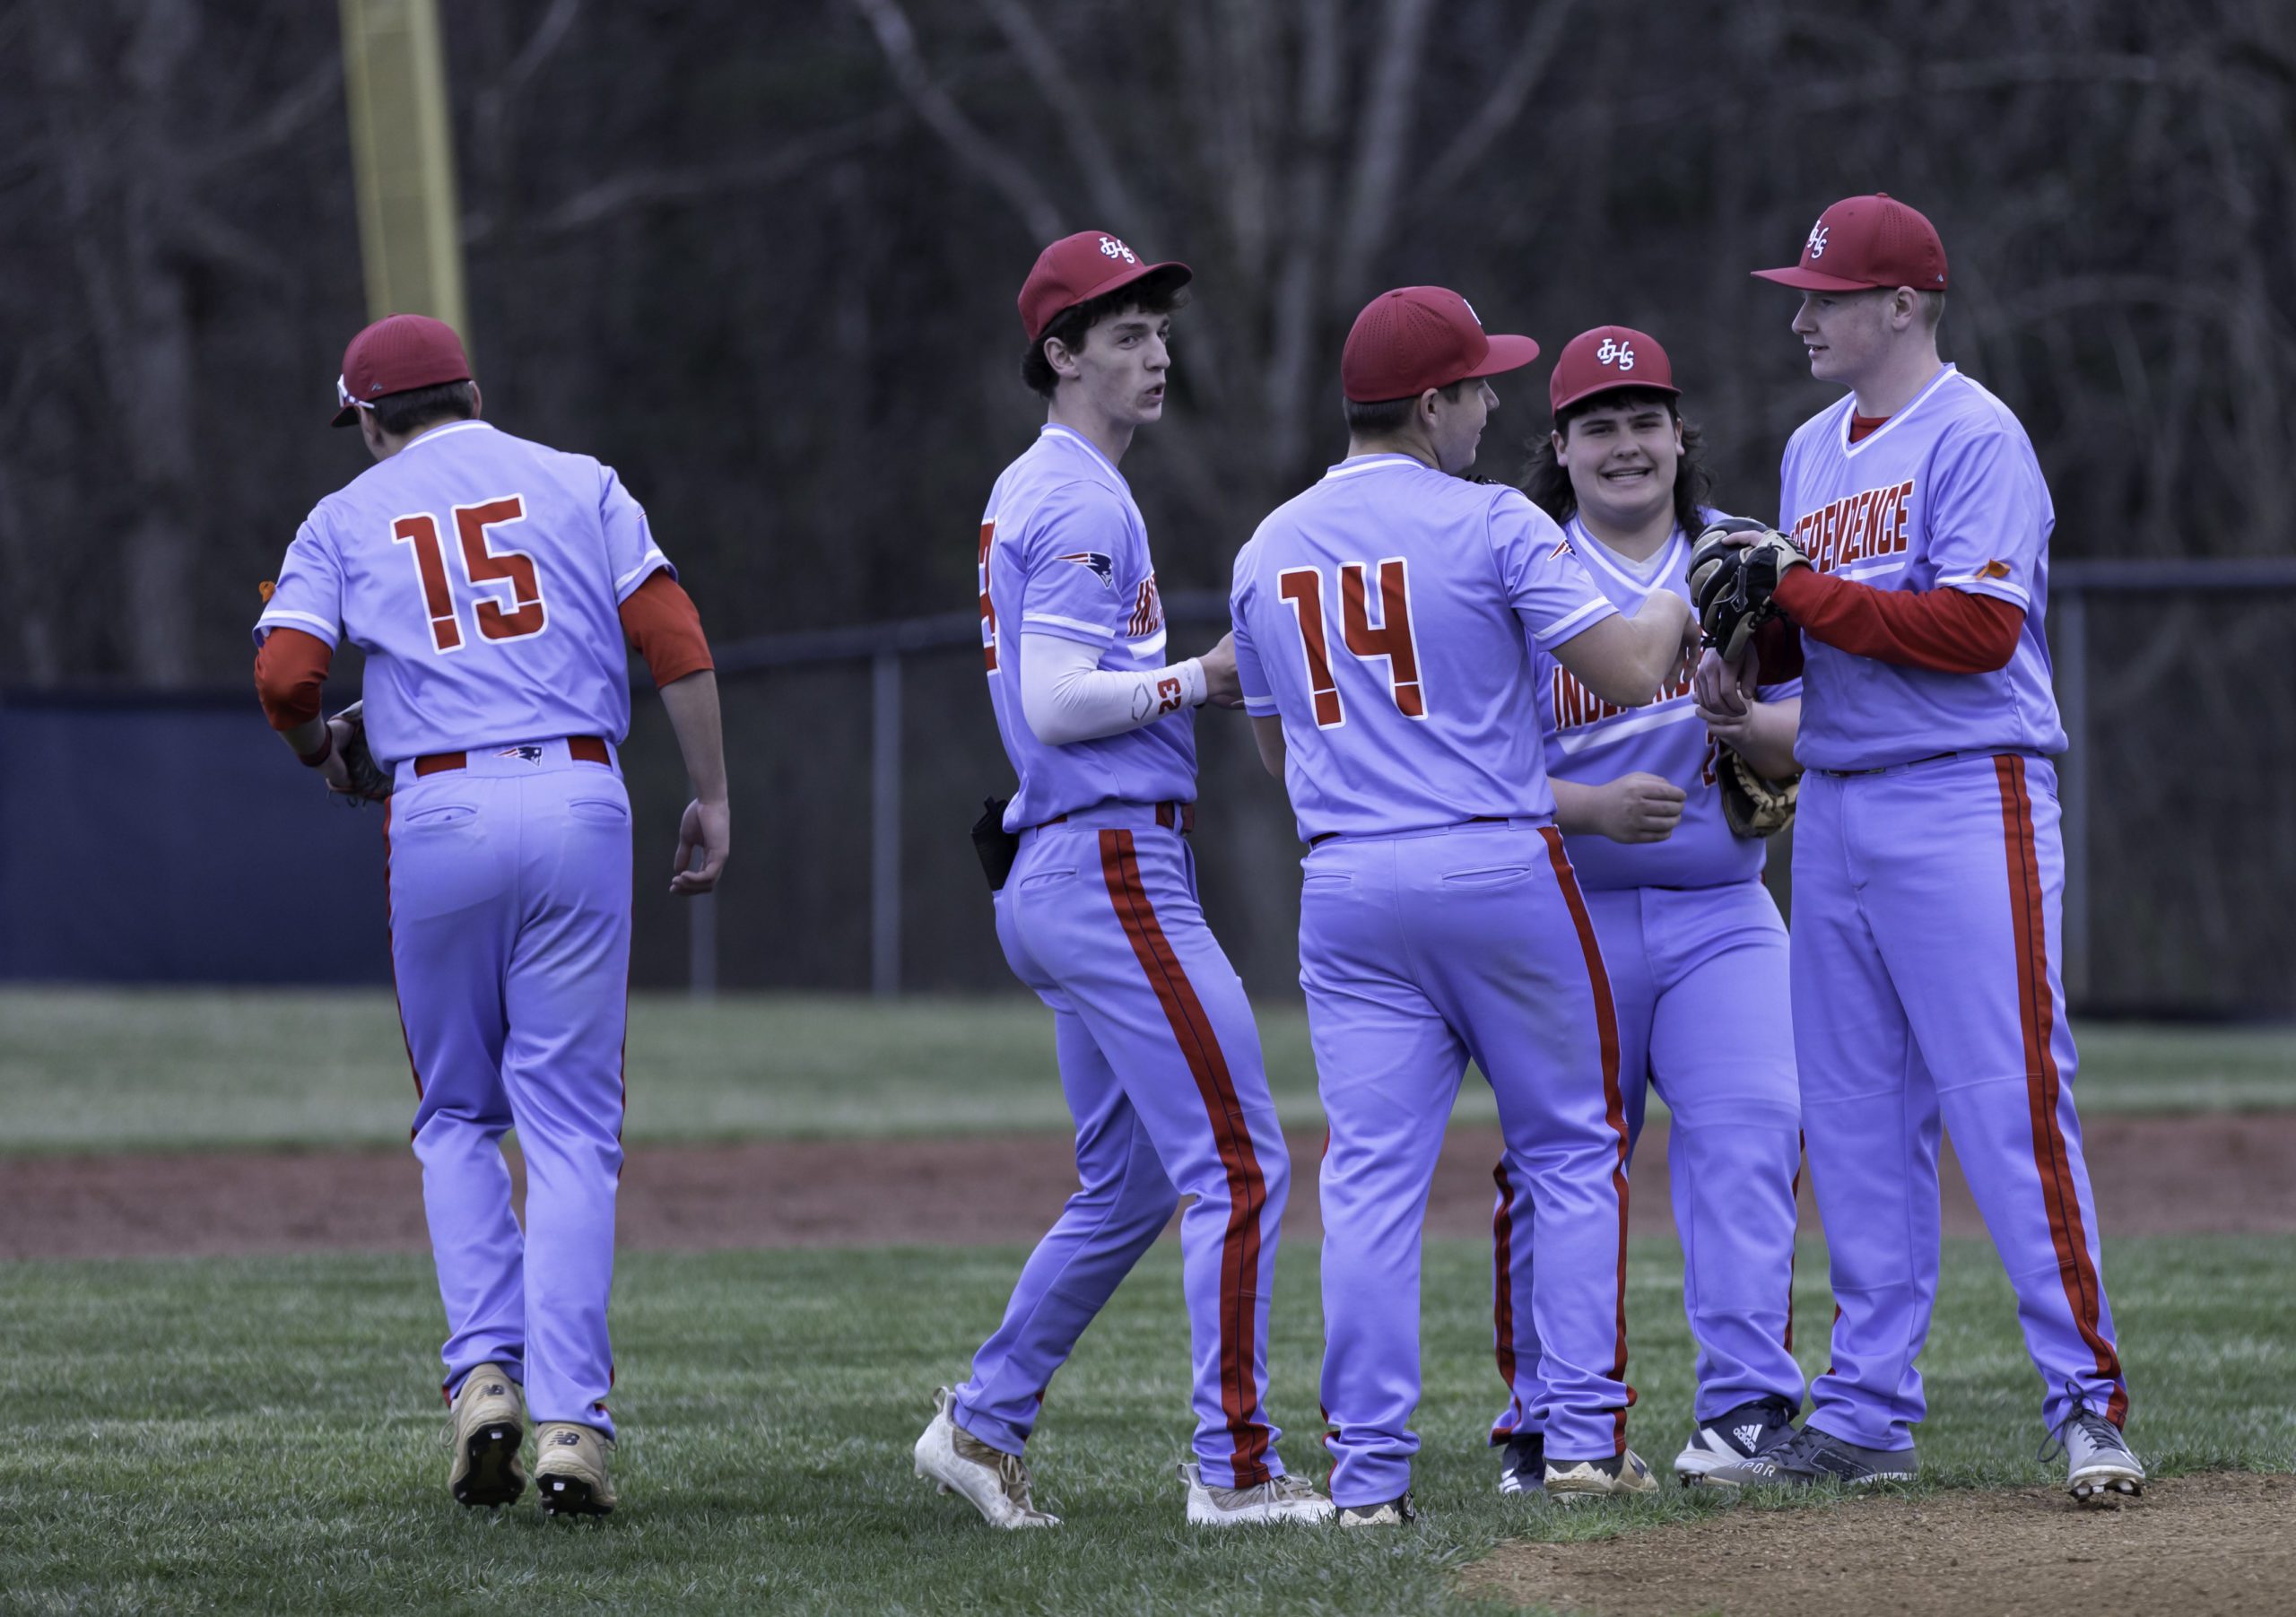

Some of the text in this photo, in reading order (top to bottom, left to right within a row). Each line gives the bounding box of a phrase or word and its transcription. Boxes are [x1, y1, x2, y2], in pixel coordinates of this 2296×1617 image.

[1596, 338, 1634, 370] IHS
[390, 492, 549, 655] 15
[1277, 556, 1429, 731] 14
[1157, 677, 1181, 715] 23
[1733, 1427, 1758, 1453] adidas
